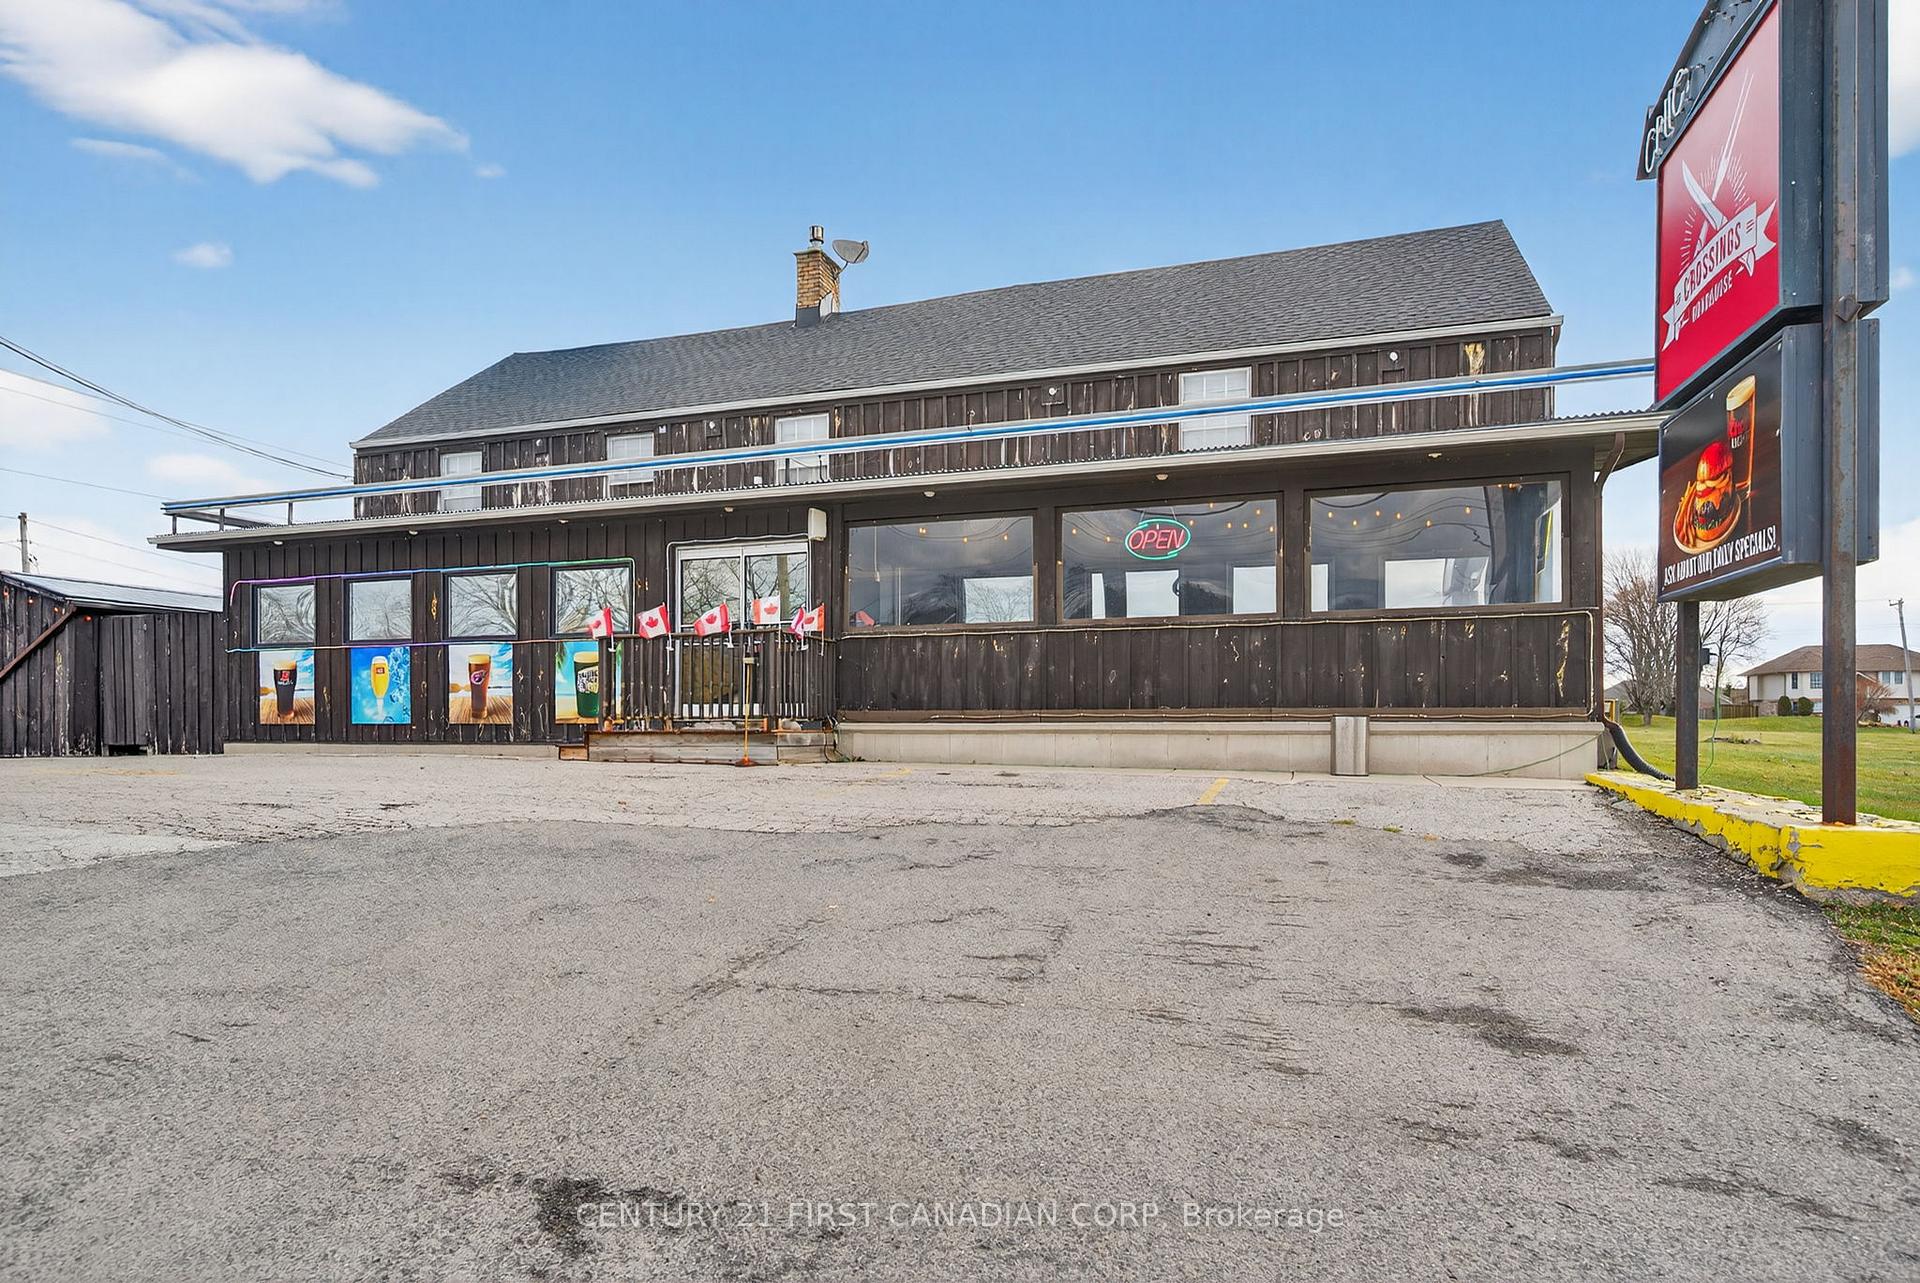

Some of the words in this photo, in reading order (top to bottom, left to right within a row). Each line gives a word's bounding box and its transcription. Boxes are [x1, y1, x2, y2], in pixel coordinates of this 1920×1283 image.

[1684, 222, 1741, 302] CROSSINGS
[1129, 529, 1185, 550] OPEN
[1664, 564, 1677, 587] ASK
[1677, 556, 1697, 582] ABOUT
[1697, 552, 1712, 575] OUR
[1713, 541, 1734, 570] DAILY
[1734, 525, 1777, 562] SPECIALS!
